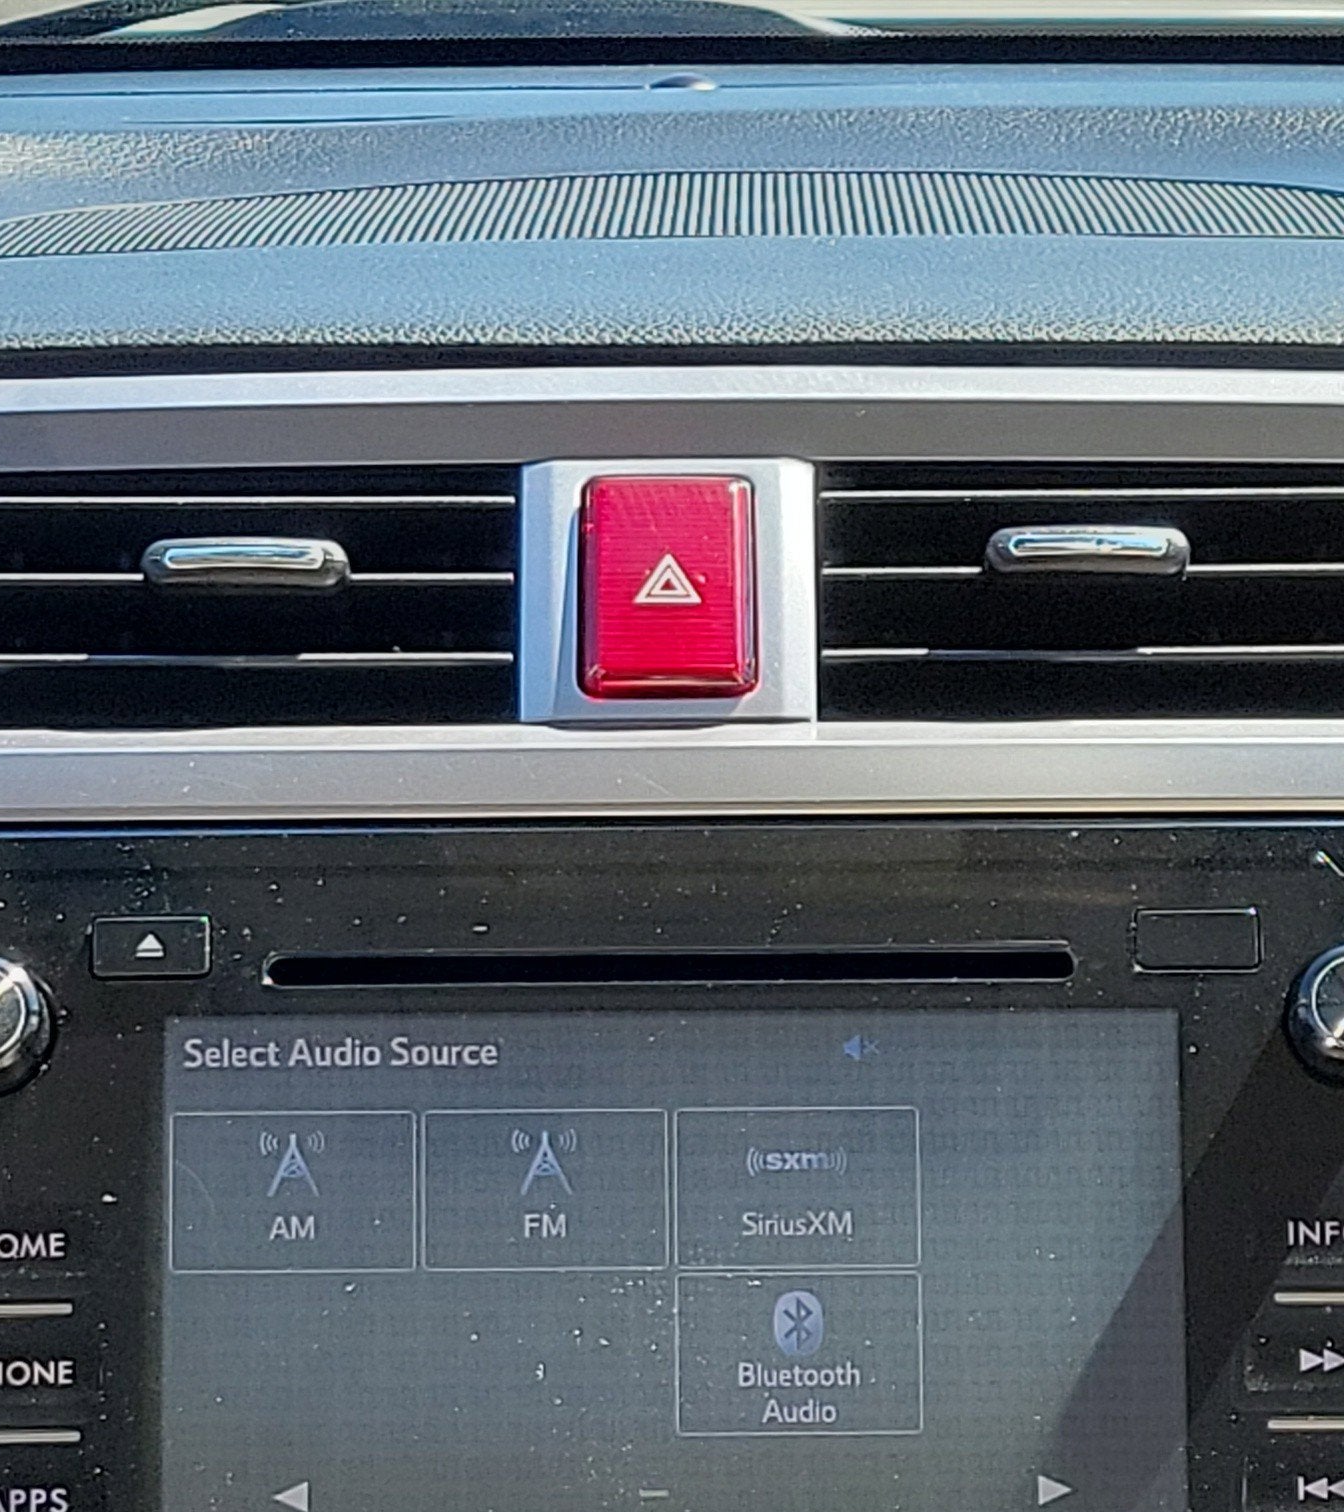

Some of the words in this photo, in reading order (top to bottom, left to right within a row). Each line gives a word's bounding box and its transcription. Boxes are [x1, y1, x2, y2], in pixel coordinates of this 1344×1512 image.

[183, 1038, 280, 1068] Select
[288, 1037, 381, 1067] Audio
[389, 1037, 499, 1067] Source
[269, 1215, 316, 1240] AM
[523, 1213, 567, 1238] FM
[742, 1210, 853, 1236] SiriusXM
[738, 1361, 860, 1387] Bluetooth
[762, 1399, 836, 1423] Audio
